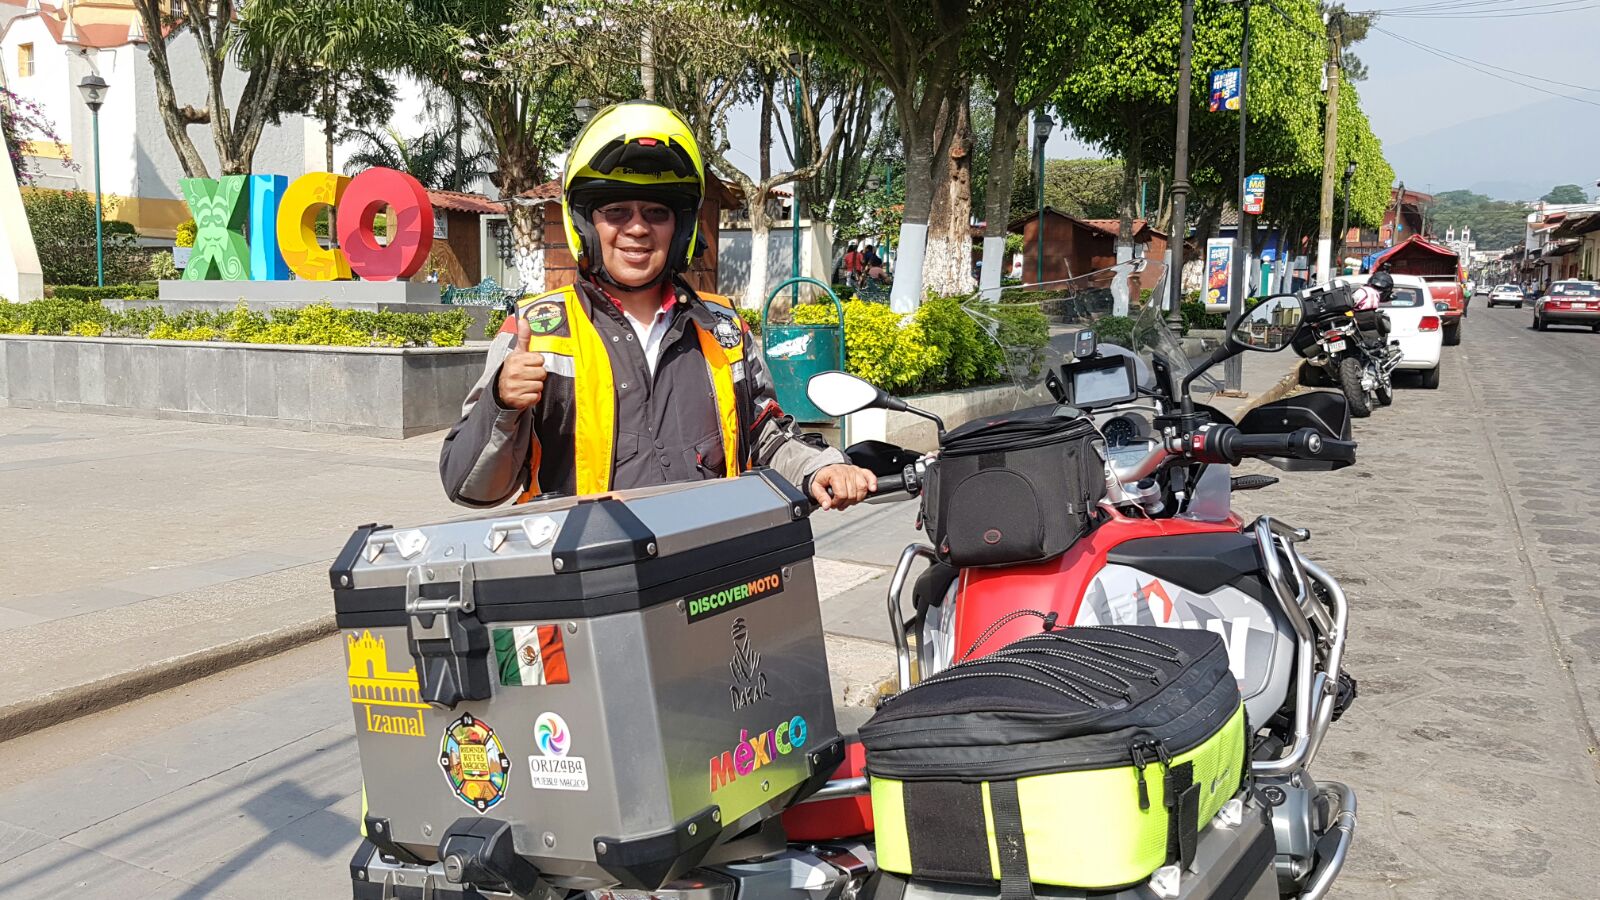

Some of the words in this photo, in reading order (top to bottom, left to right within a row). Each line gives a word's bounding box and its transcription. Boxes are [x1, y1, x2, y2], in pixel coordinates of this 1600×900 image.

[178, 167, 433, 281] XICO
[688, 573, 780, 617] DISCOVERMOTO
[729, 672, 771, 713] DAKAR
[364, 704, 427, 737] Izamal
[464, 716, 472, 724] N
[501, 759, 509, 767] E
[477, 801, 485, 809] S
